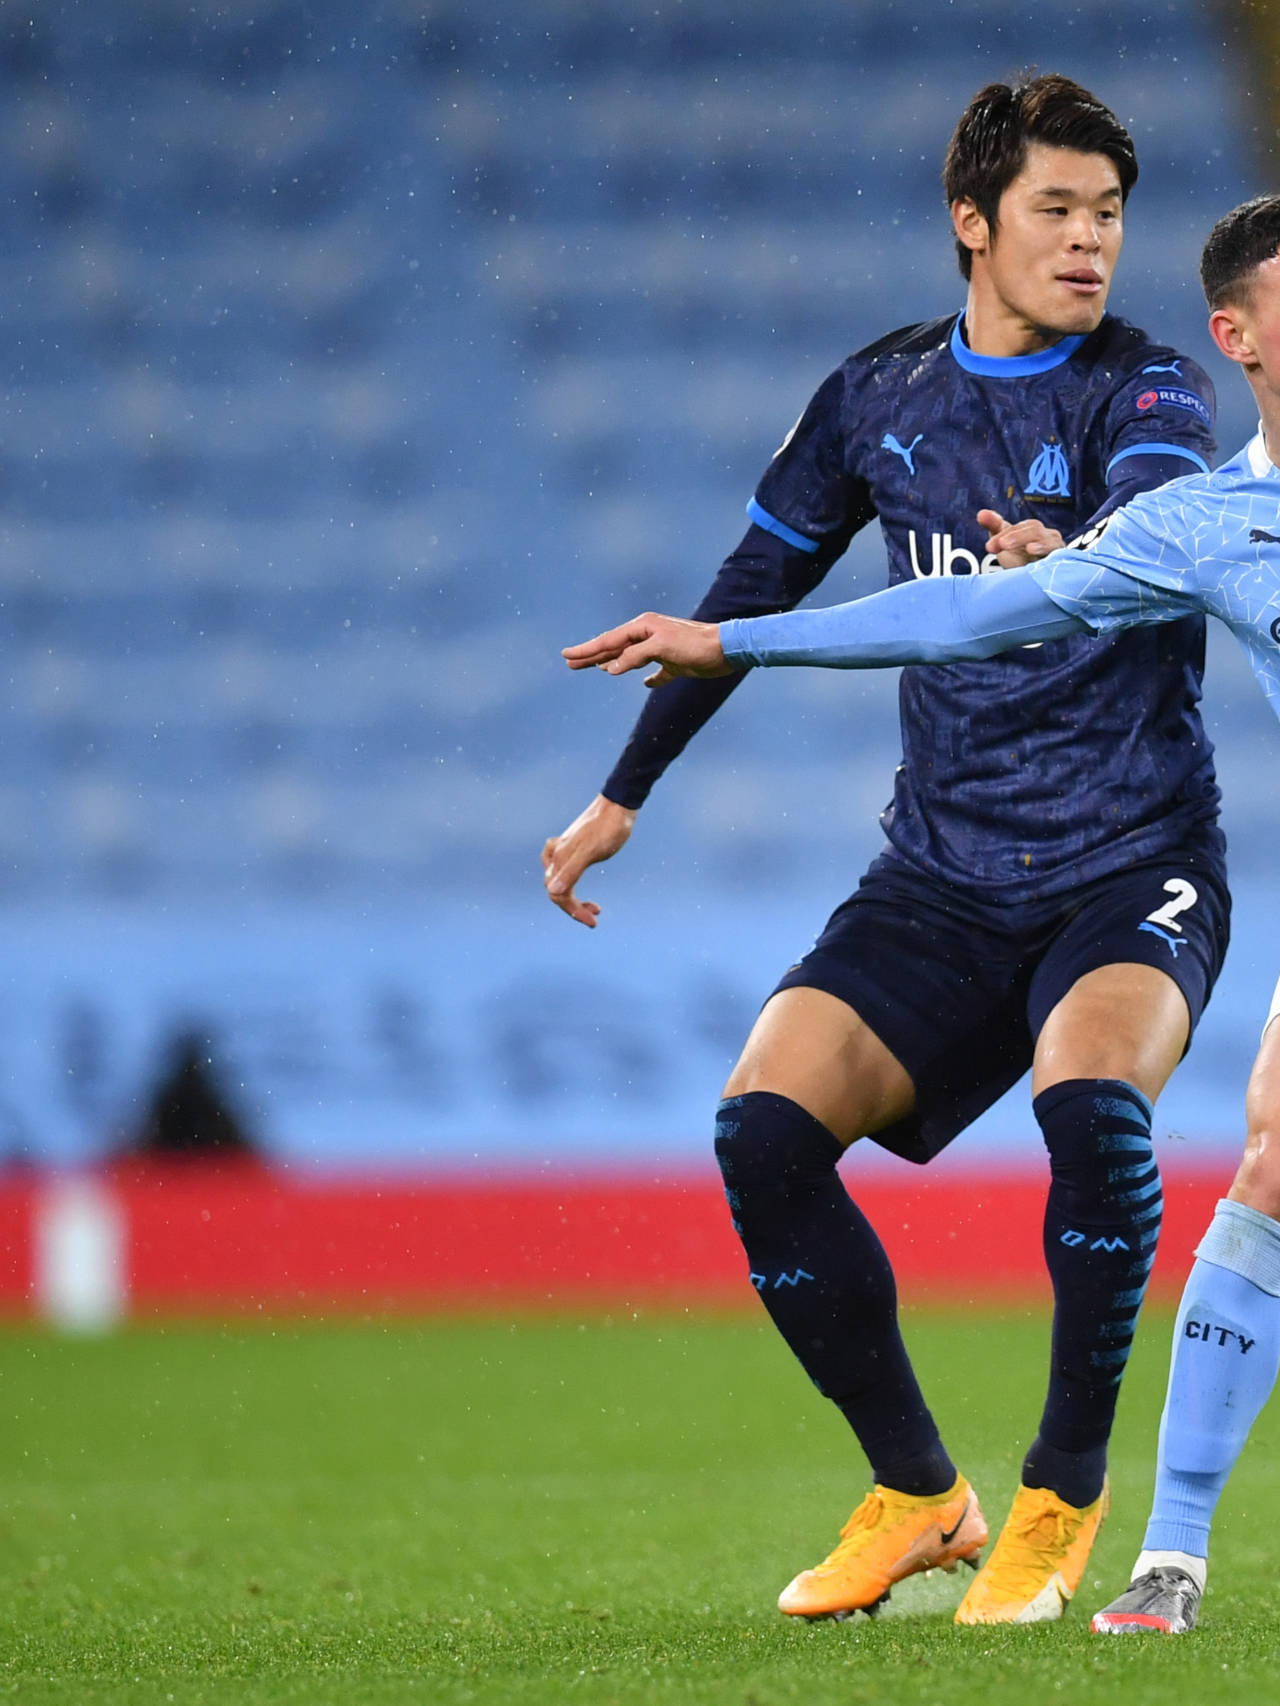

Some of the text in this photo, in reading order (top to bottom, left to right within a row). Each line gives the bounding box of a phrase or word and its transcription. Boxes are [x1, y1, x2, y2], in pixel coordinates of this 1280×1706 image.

[1160, 391, 1210, 418] RESPEC
[908, 529, 1005, 580] Ube
[1145, 877, 1198, 933] 2
[1185, 1320, 1256, 1355] CITY
